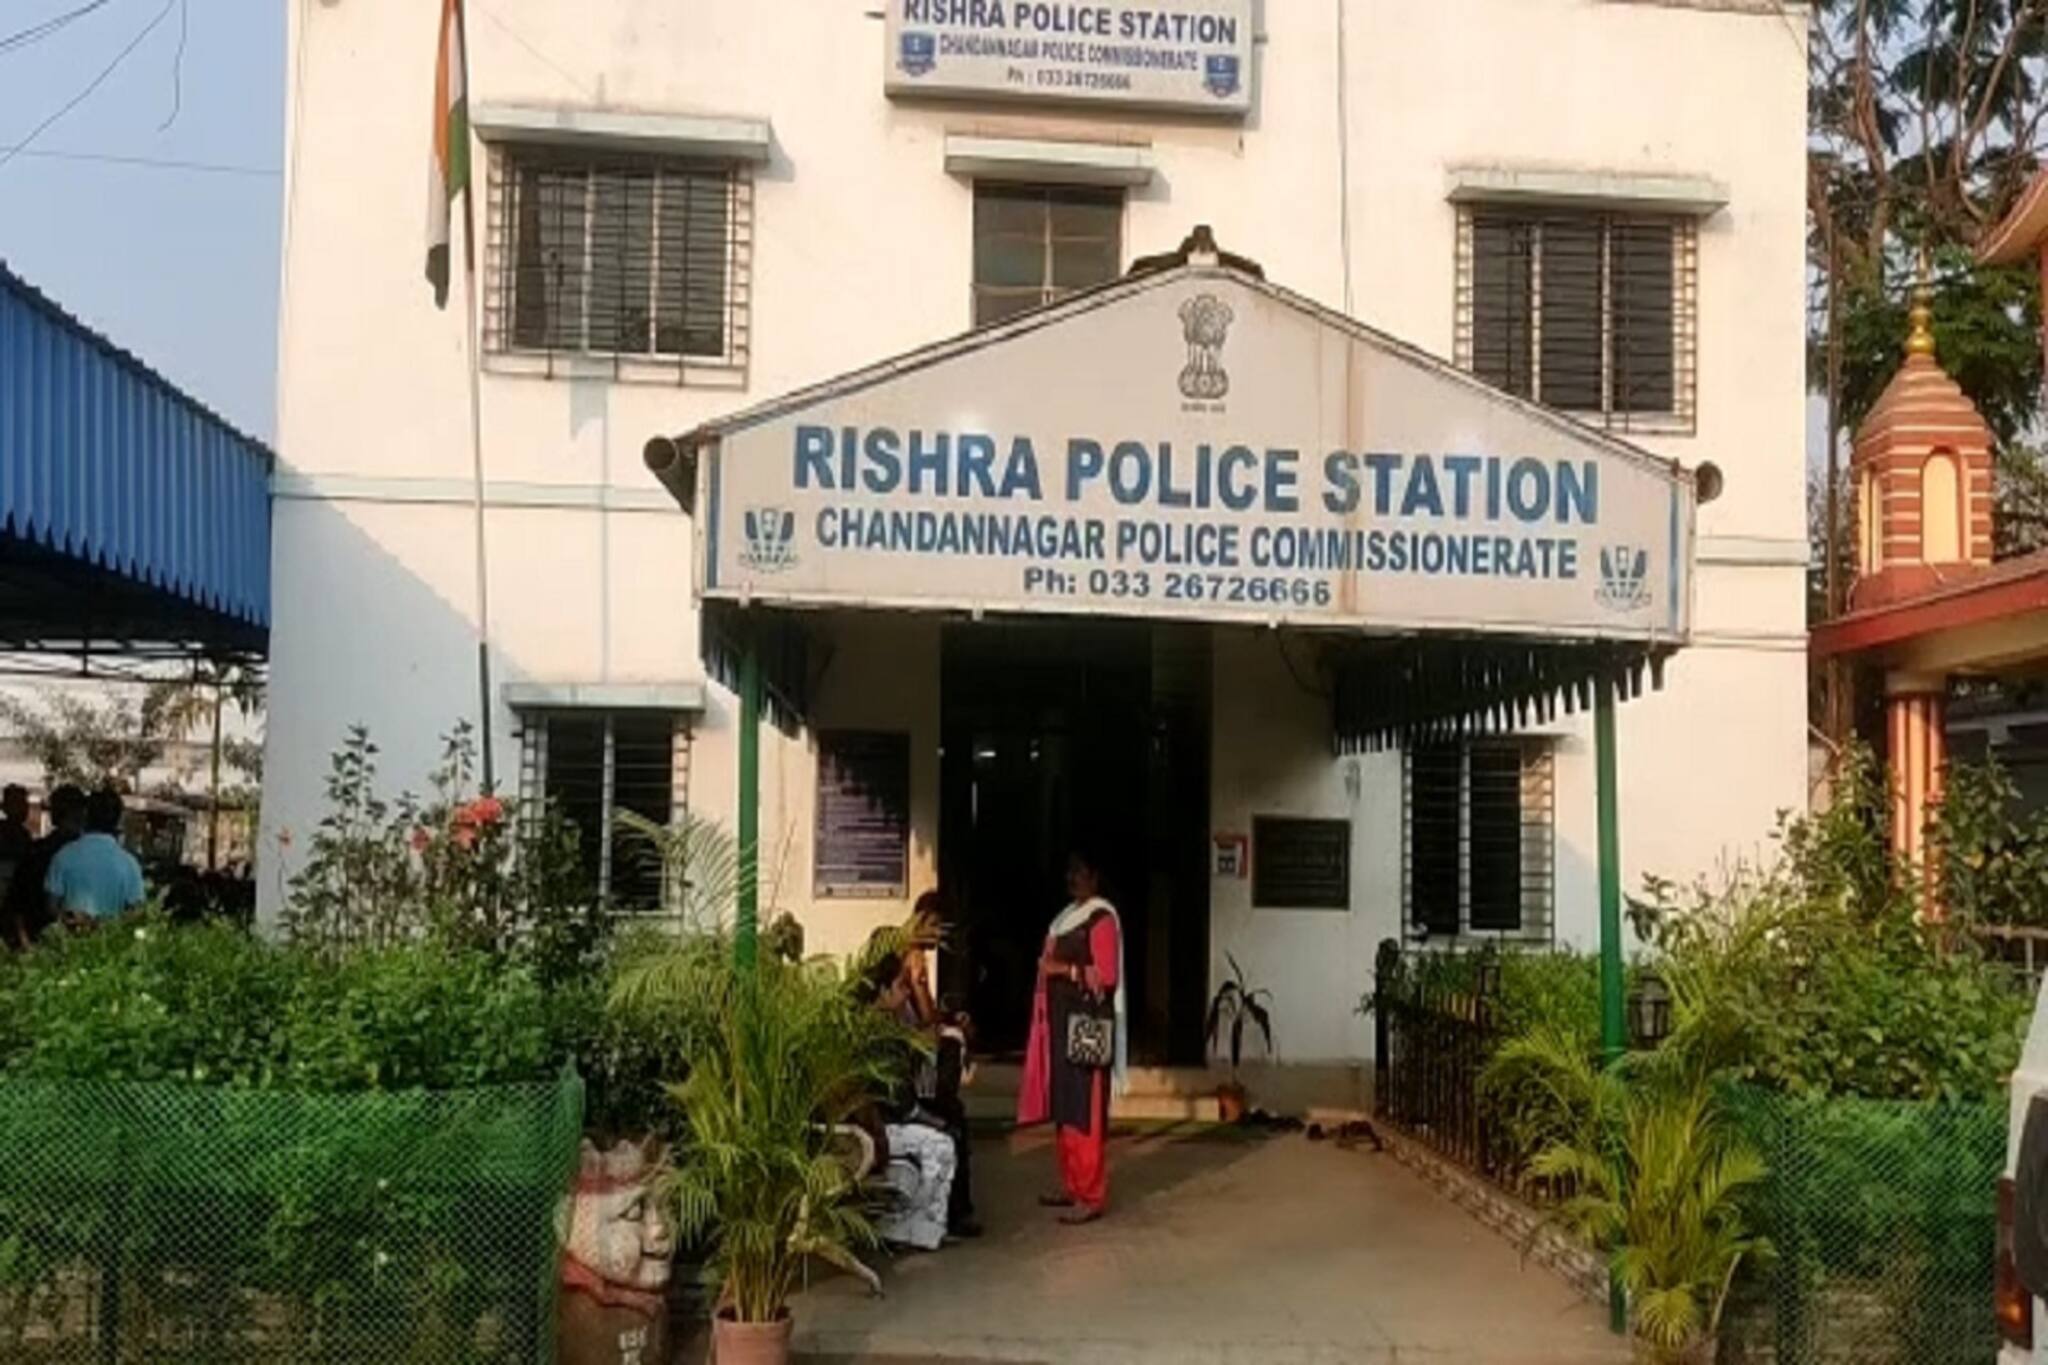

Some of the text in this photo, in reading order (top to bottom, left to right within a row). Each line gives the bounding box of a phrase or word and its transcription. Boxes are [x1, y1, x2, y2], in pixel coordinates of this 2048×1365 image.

[903, 0, 1236, 44] RISHRA POLICE STATION
[1042, 42, 1084, 62] POLICE
[793, 425, 1598, 525] RISHRA POLICE STATION
[816, 506, 1578, 580] CHANDANNAGAR POLICE COMMISSIONERATE
[1023, 567, 1331, 606] Ph: 033 26726666
